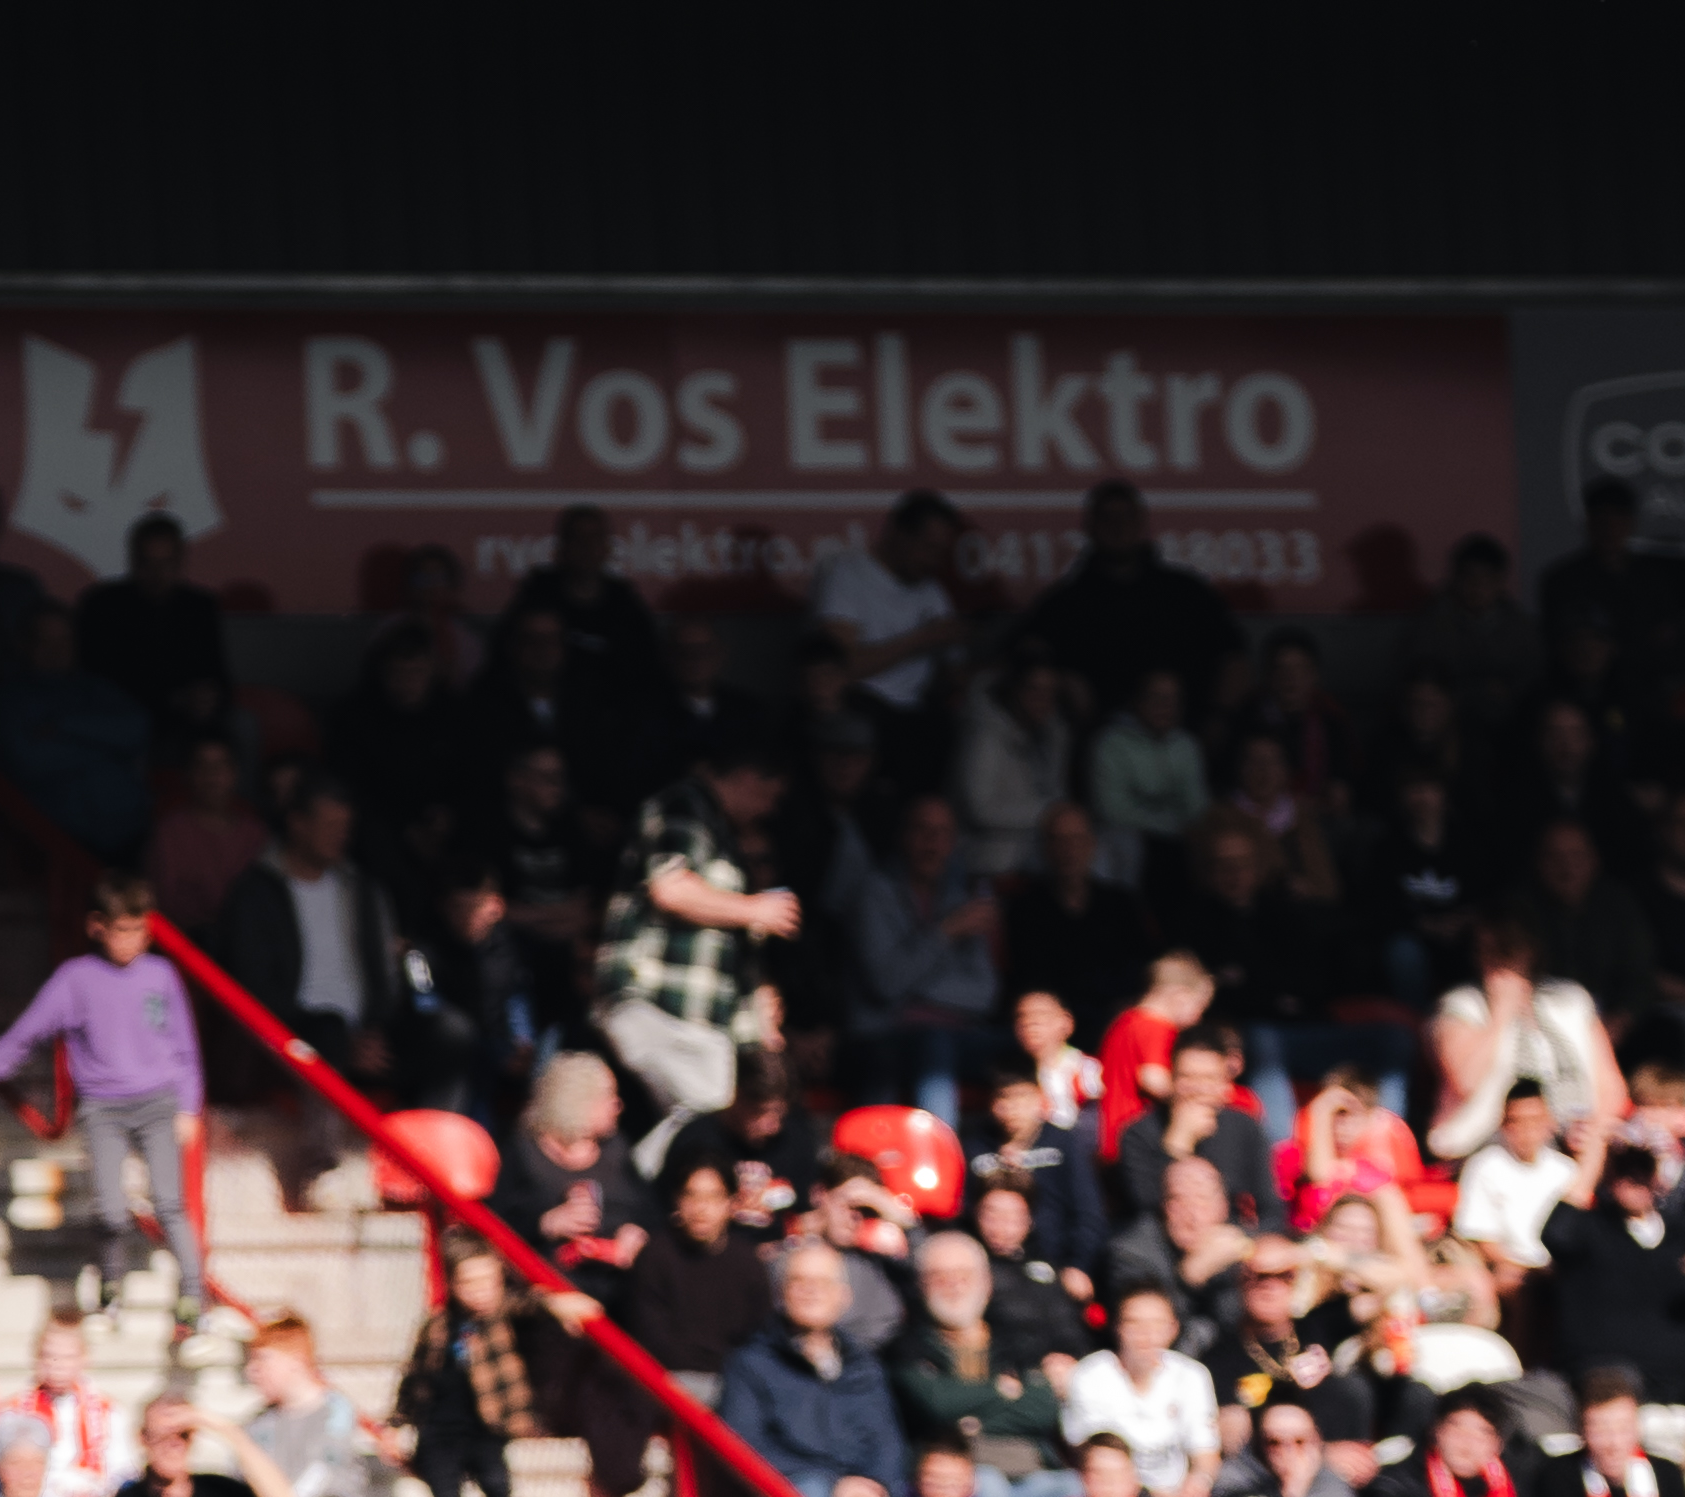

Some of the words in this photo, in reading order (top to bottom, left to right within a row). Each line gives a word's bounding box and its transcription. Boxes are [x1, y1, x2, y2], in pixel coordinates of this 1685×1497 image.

[302, 335, 442, 475] R.
[469, 335, 746, 477] Vos
[784, 329, 1319, 477] Elektro
